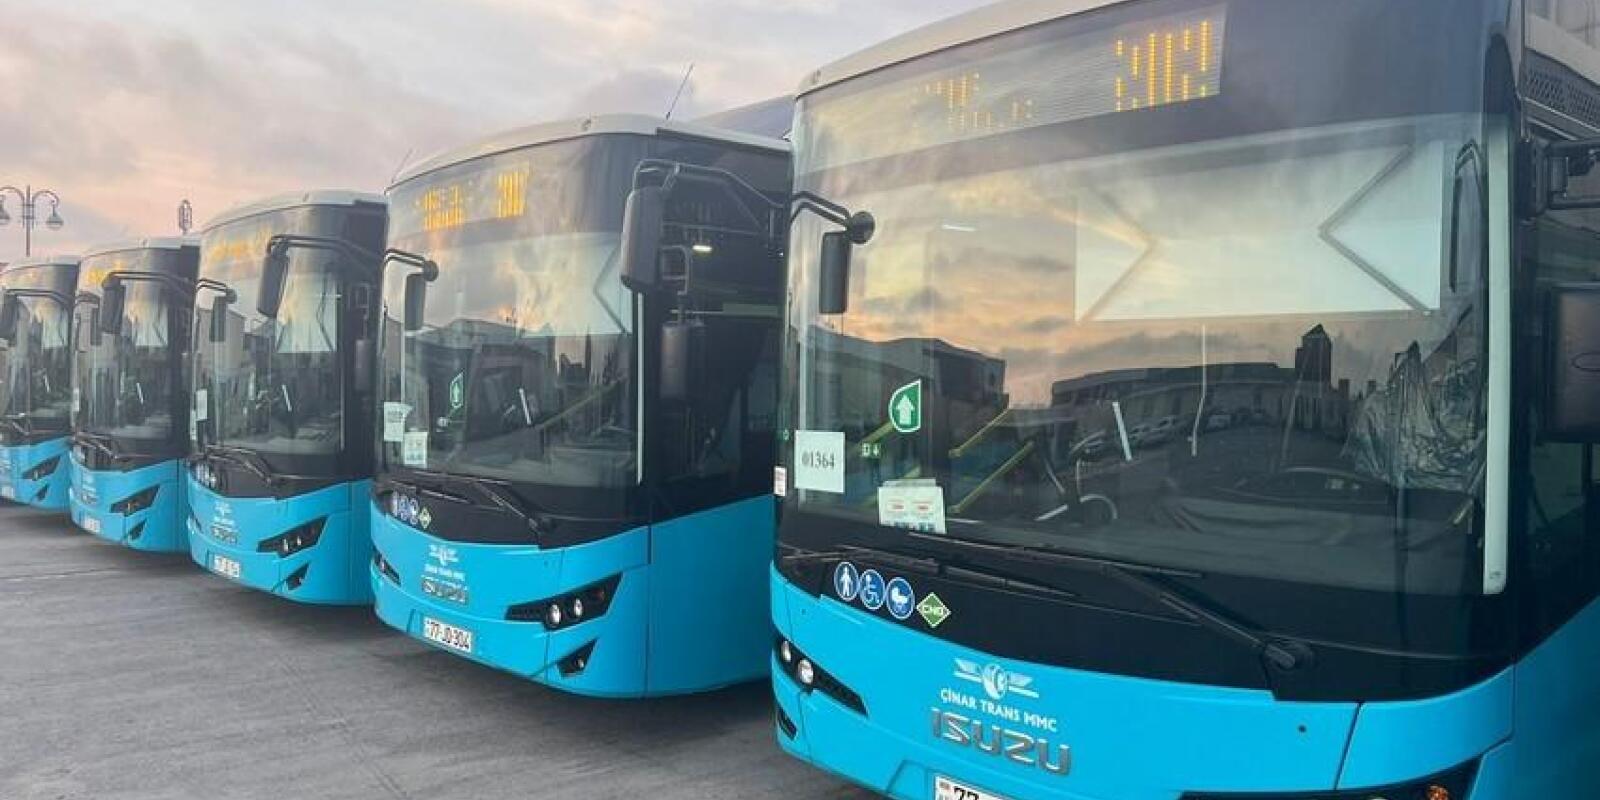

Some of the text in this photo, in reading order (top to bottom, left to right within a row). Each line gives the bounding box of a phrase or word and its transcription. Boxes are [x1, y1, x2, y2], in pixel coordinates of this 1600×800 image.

[801, 450, 836, 470] 01364
[980, 699, 1021, 722] TRANS
[1023, 711, 1057, 733] MMC
[930, 706, 1072, 775] ISUZU
